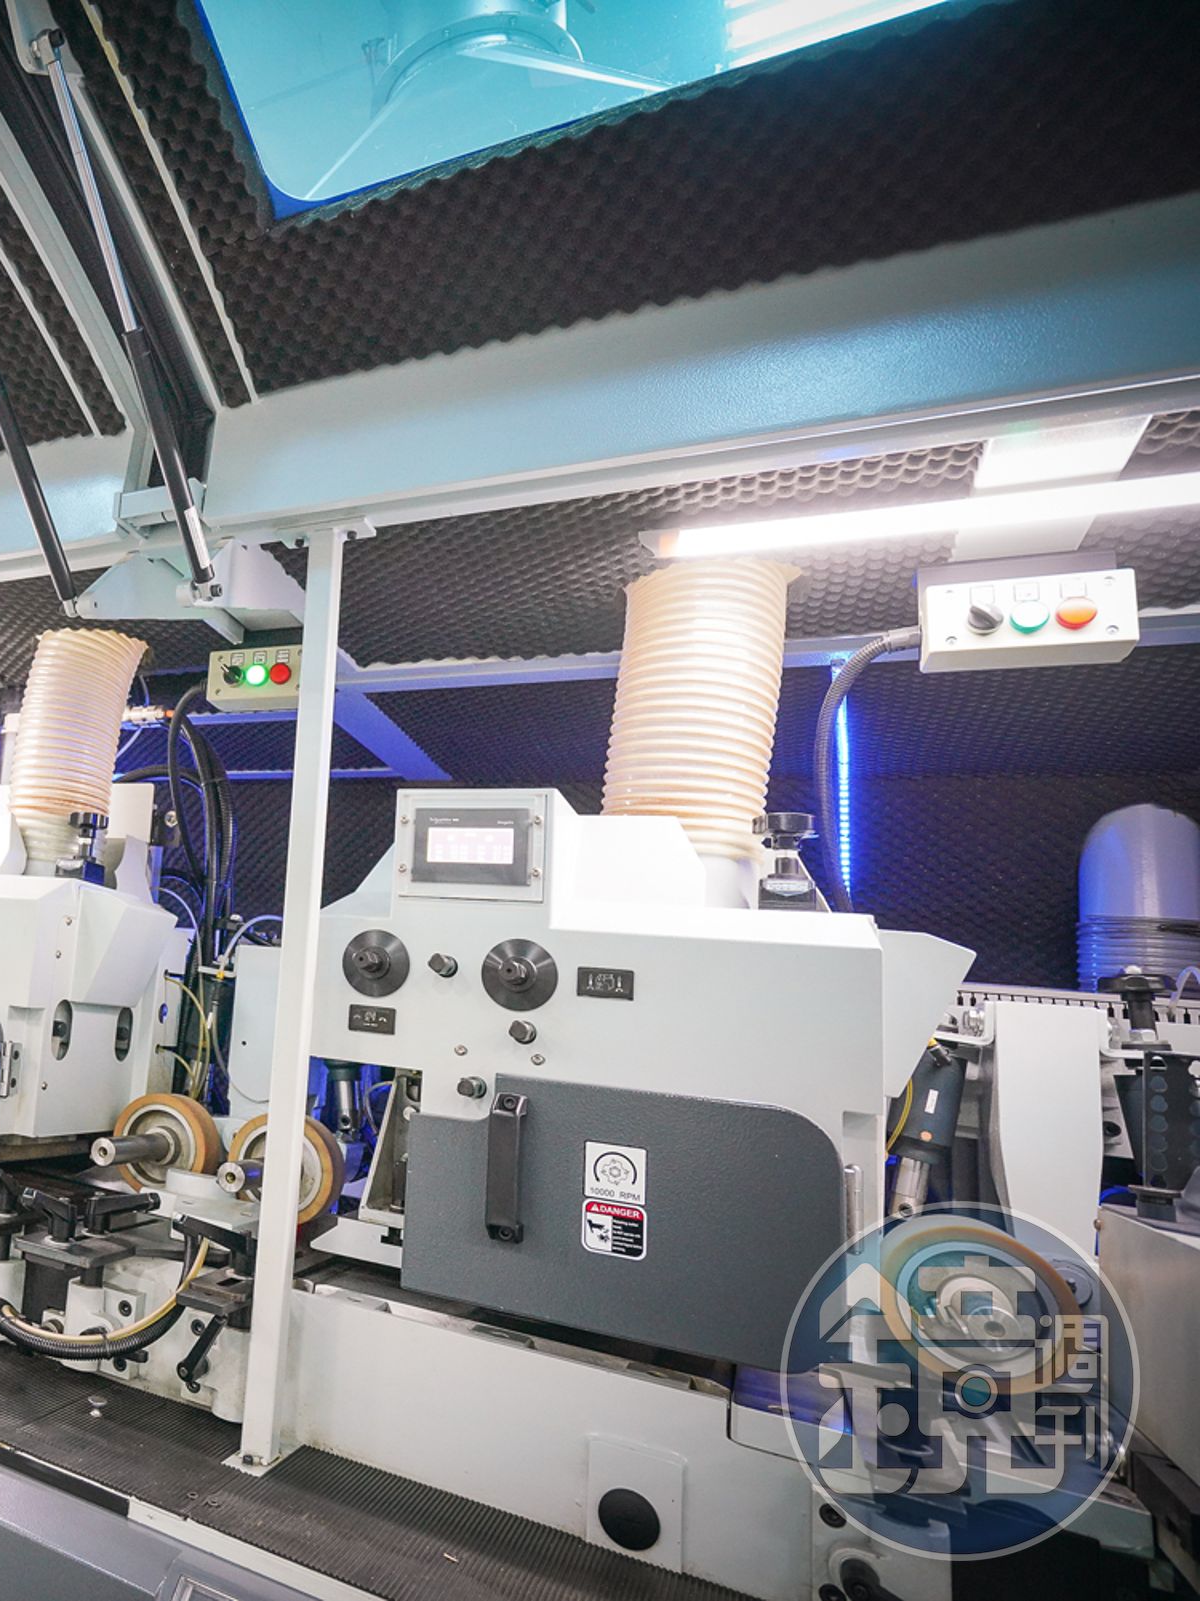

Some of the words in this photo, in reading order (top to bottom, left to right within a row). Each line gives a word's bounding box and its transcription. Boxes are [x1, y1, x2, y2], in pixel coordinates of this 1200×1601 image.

[590, 1187, 615, 1198] 10000
[619, 1191, 641, 1202] RPM
[600, 1205, 640, 1219] DANGER
